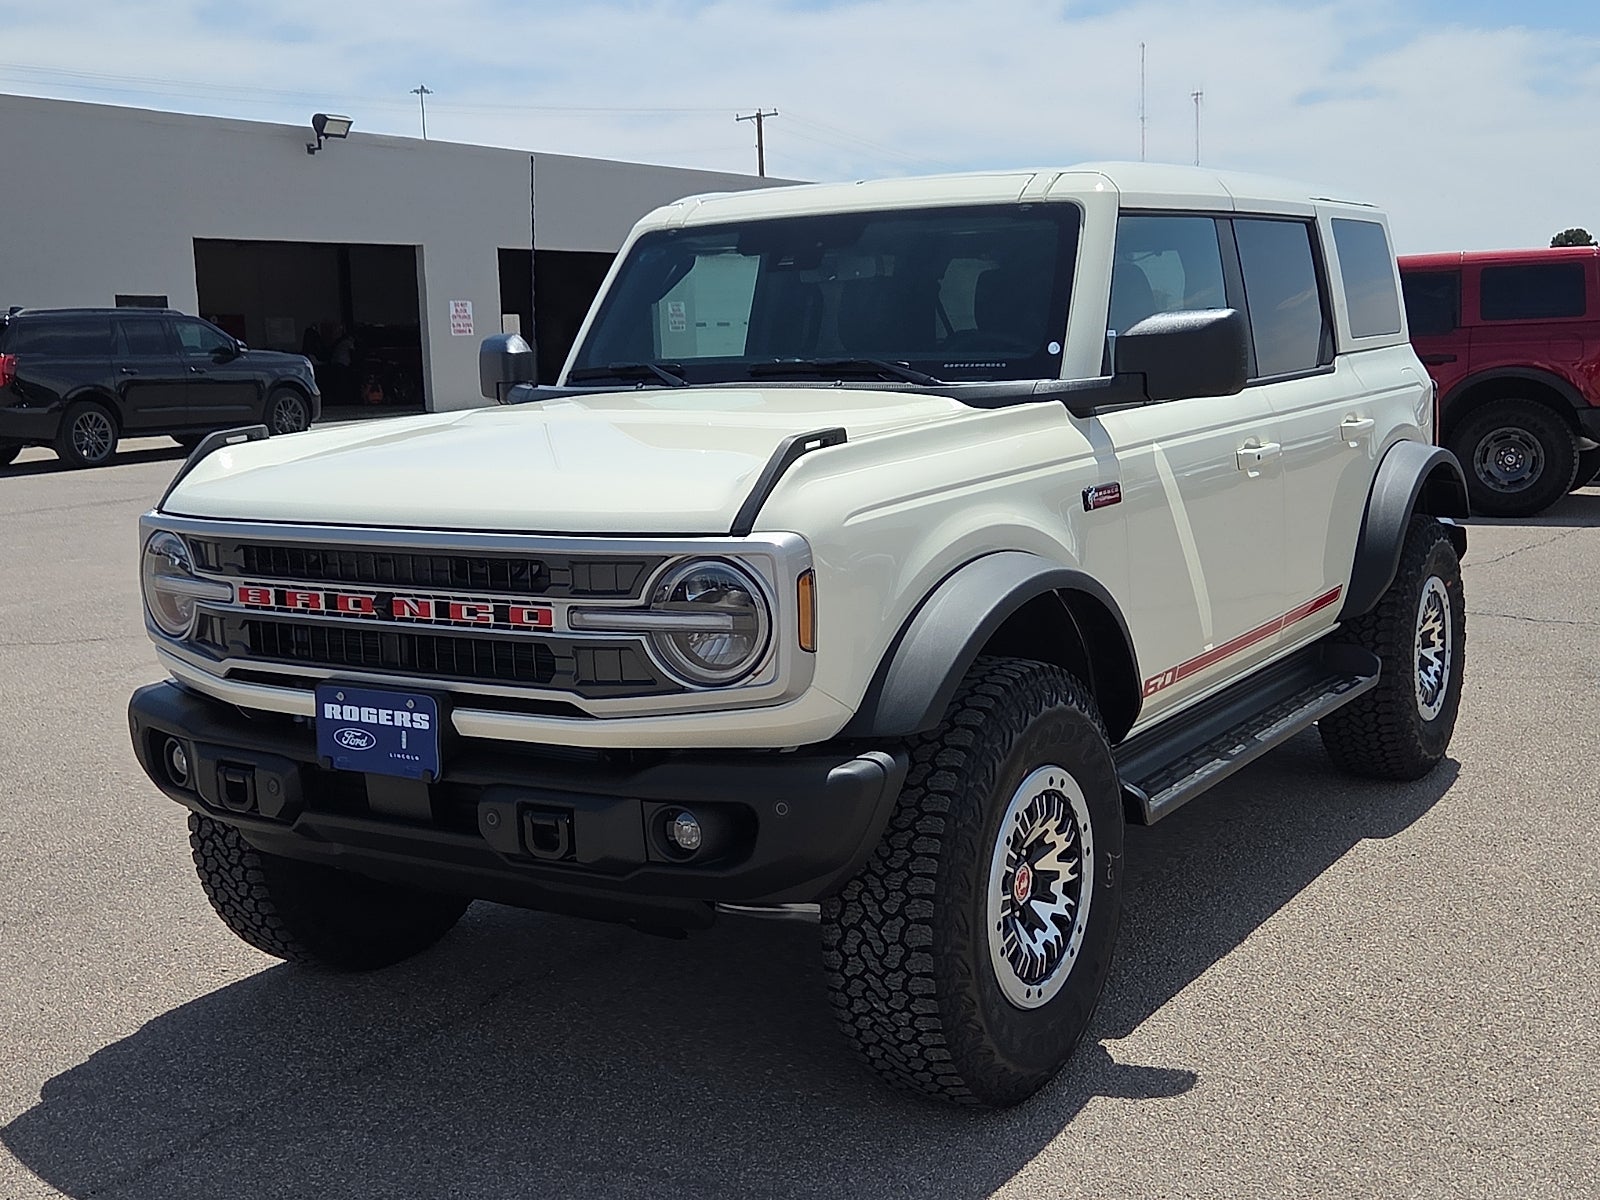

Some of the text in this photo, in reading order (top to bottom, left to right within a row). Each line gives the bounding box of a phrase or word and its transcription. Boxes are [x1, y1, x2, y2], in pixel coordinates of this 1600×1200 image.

[238, 586, 554, 628] BRONCO
[324, 703, 430, 730] ROGERS
[341, 730, 368, 748] Ford
